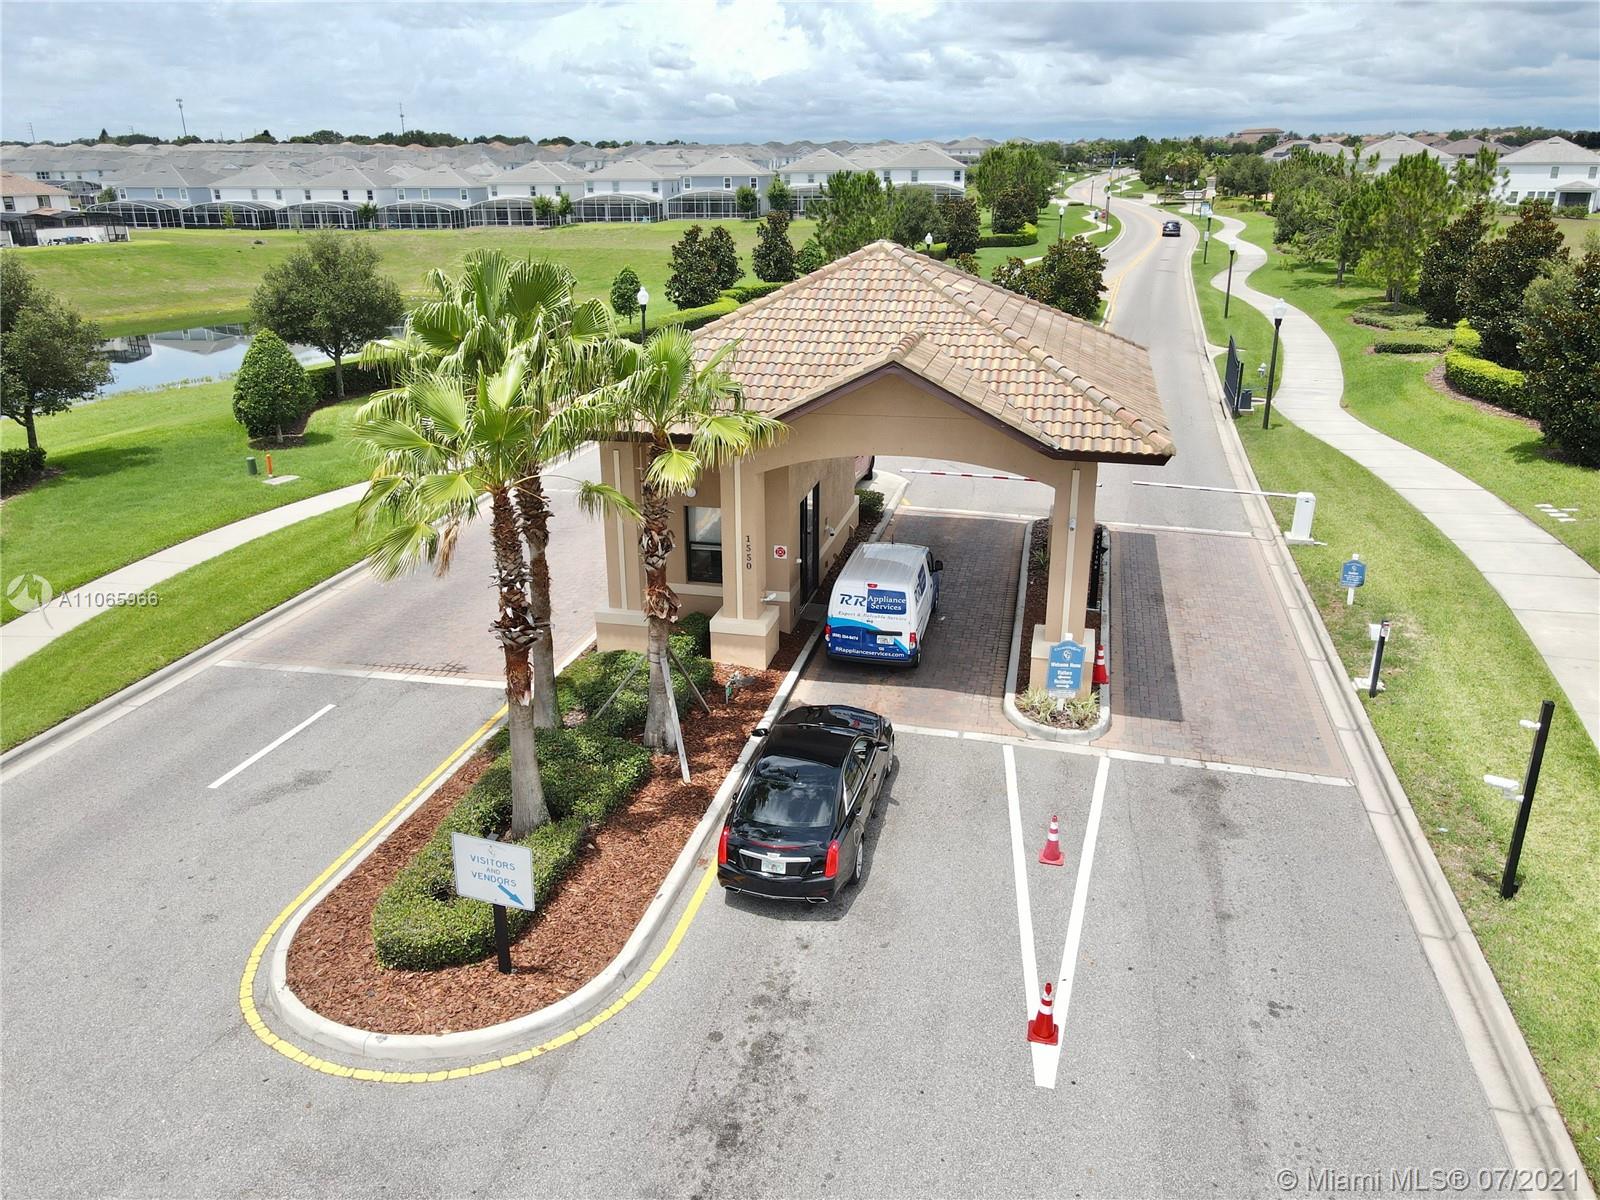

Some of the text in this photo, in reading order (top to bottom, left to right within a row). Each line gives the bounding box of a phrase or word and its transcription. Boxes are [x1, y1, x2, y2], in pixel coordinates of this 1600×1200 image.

[840, 593, 866, 607] RR
[867, 596, 906, 604] Appliance
[870, 603, 902, 611] Services
[469, 854, 516, 871] VISITORS
[486, 867, 501, 875] AND
[471, 871, 517, 887] VENDORS
